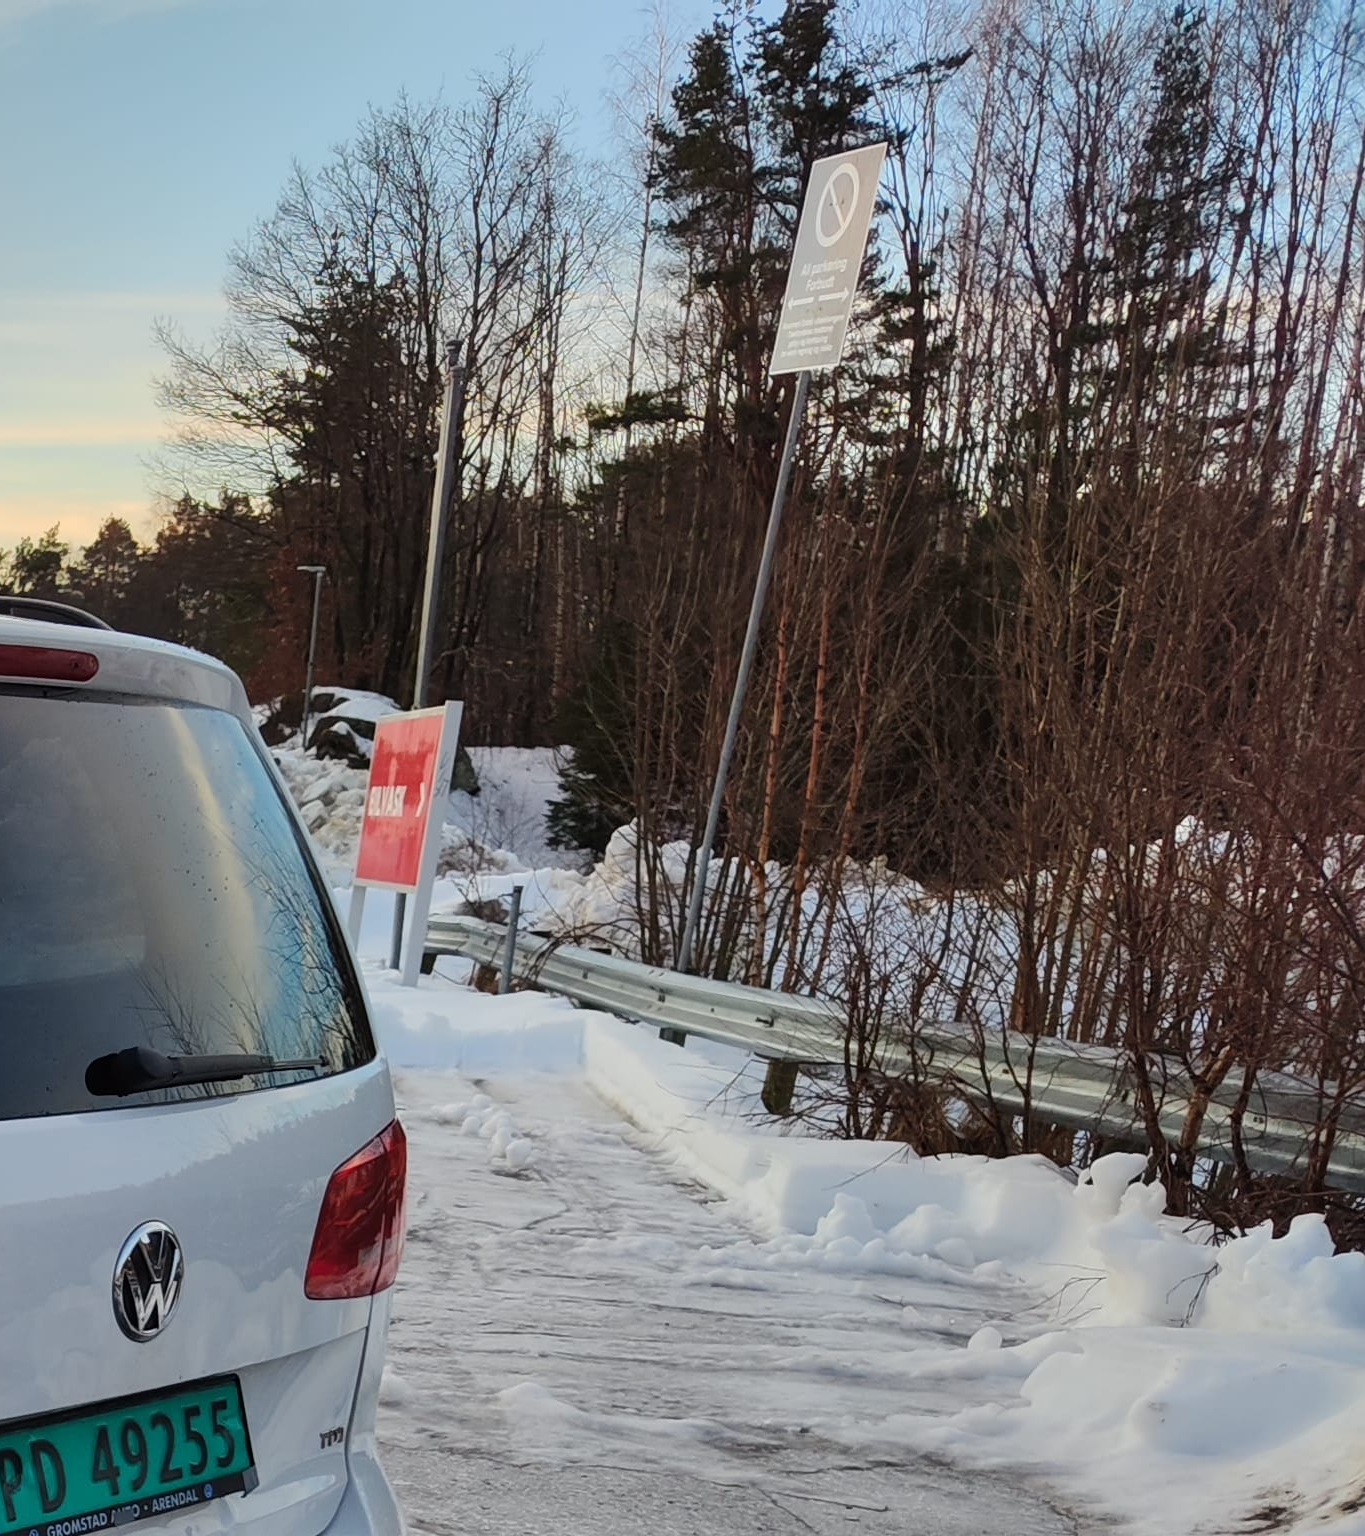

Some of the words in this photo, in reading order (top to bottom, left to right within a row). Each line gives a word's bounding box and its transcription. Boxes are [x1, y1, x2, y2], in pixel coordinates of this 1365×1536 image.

[91, 1399, 237, 1496] 49255
[110, 1503, 140, 1524] AO
[152, 1488, 199, 1513] ARENDAL
